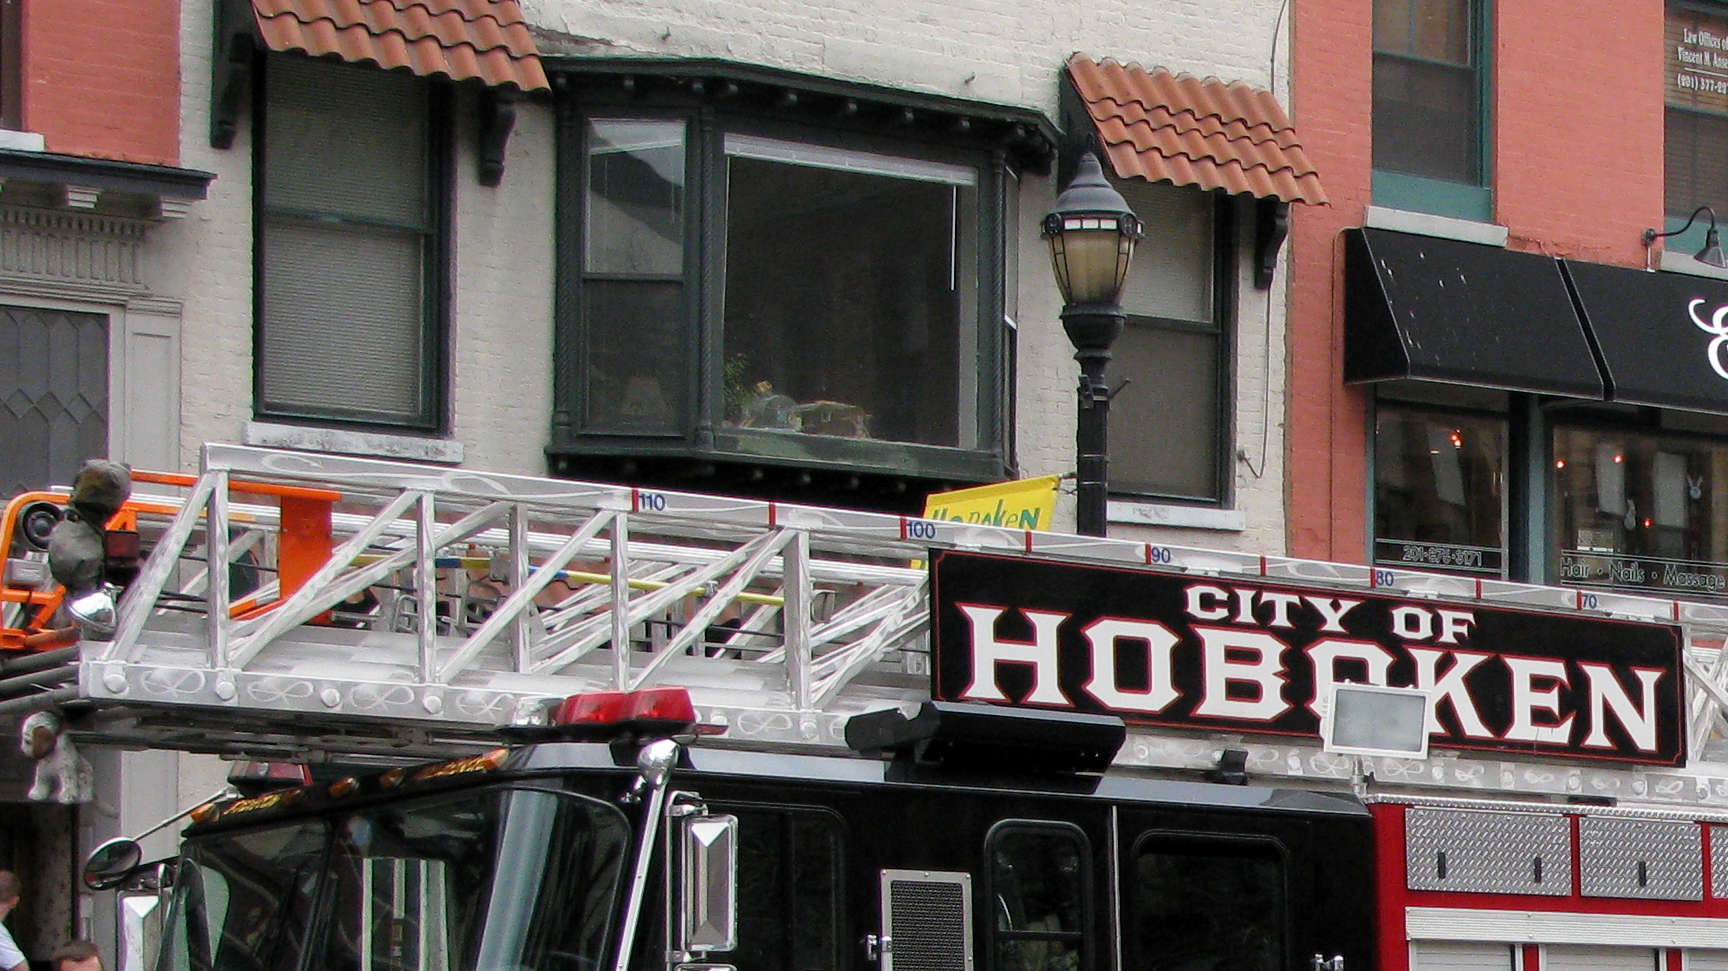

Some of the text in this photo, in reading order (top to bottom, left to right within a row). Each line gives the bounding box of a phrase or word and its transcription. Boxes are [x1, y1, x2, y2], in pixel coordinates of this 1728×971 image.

[1683, 28, 1698, 44] Law
[1698, 31, 1721, 49] Offices
[1677, 73, 1699, 91] (201)
[638, 494, 666, 511] 110
[906, 521, 936, 539] 100
[1151, 546, 1171, 564] 90
[1376, 571, 1395, 586] 80
[1560, 556, 1591, 578] Hair
[1608, 559, 1645, 583] Nails
[1663, 563, 1726, 592] Massage
[1582, 594, 1598, 609] 70
[1185, 584, 1477, 645] CITY OF
[956, 600, 1668, 753] HOBOKEN
